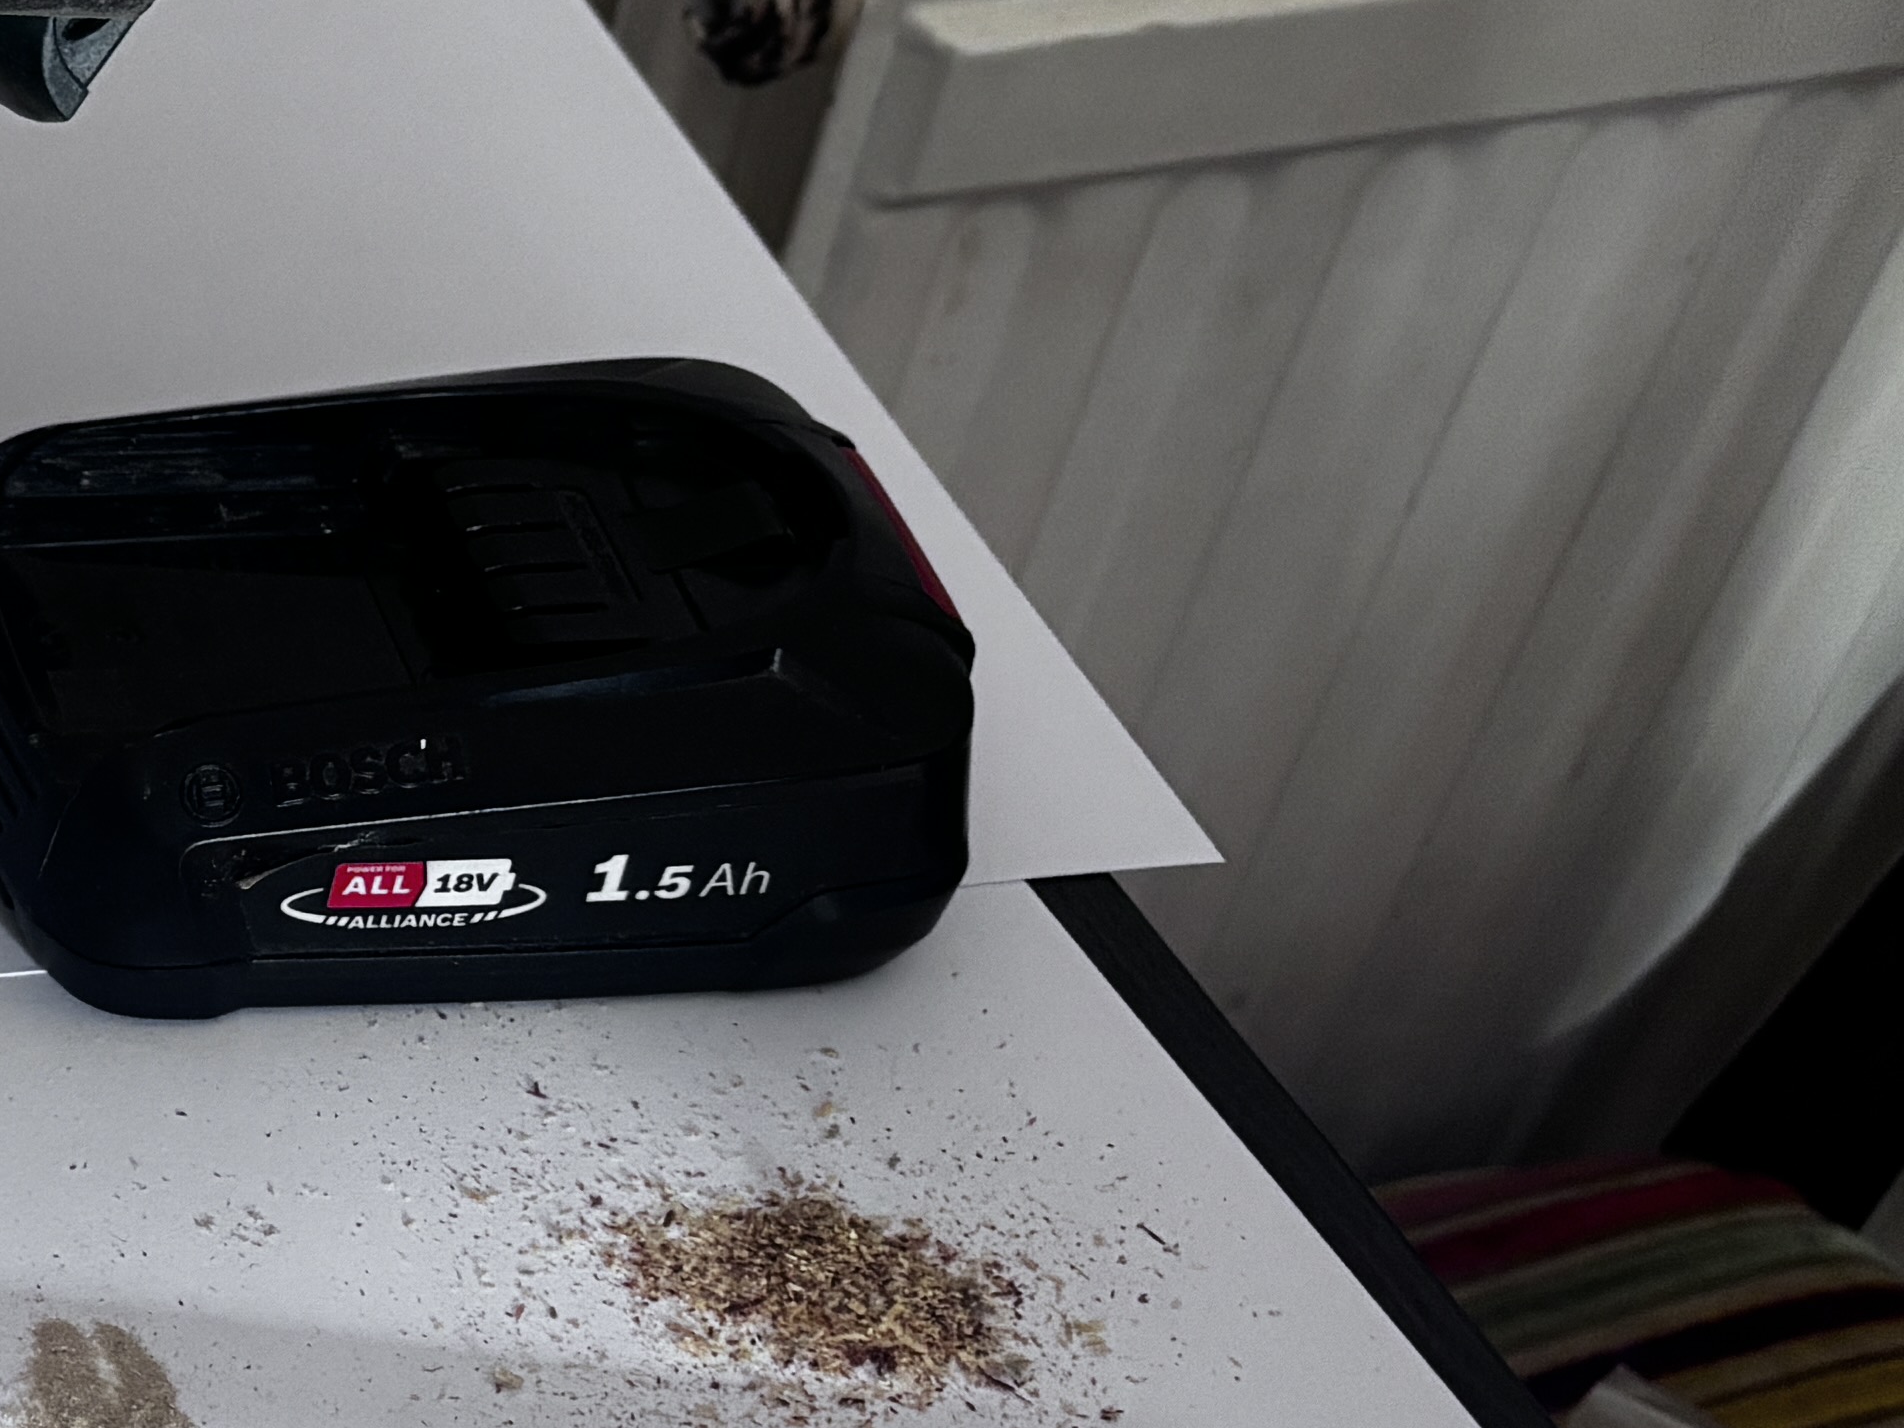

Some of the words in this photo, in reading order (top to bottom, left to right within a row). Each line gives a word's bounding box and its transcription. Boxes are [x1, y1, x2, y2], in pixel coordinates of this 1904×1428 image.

[269, 732, 468, 808] BOSCH
[341, 874, 411, 896] ALL
[433, 872, 500, 894] 18V
[585, 854, 697, 903] 1.5
[699, 860, 772, 897] Ah
[347, 912, 470, 930] ALLIANCE
